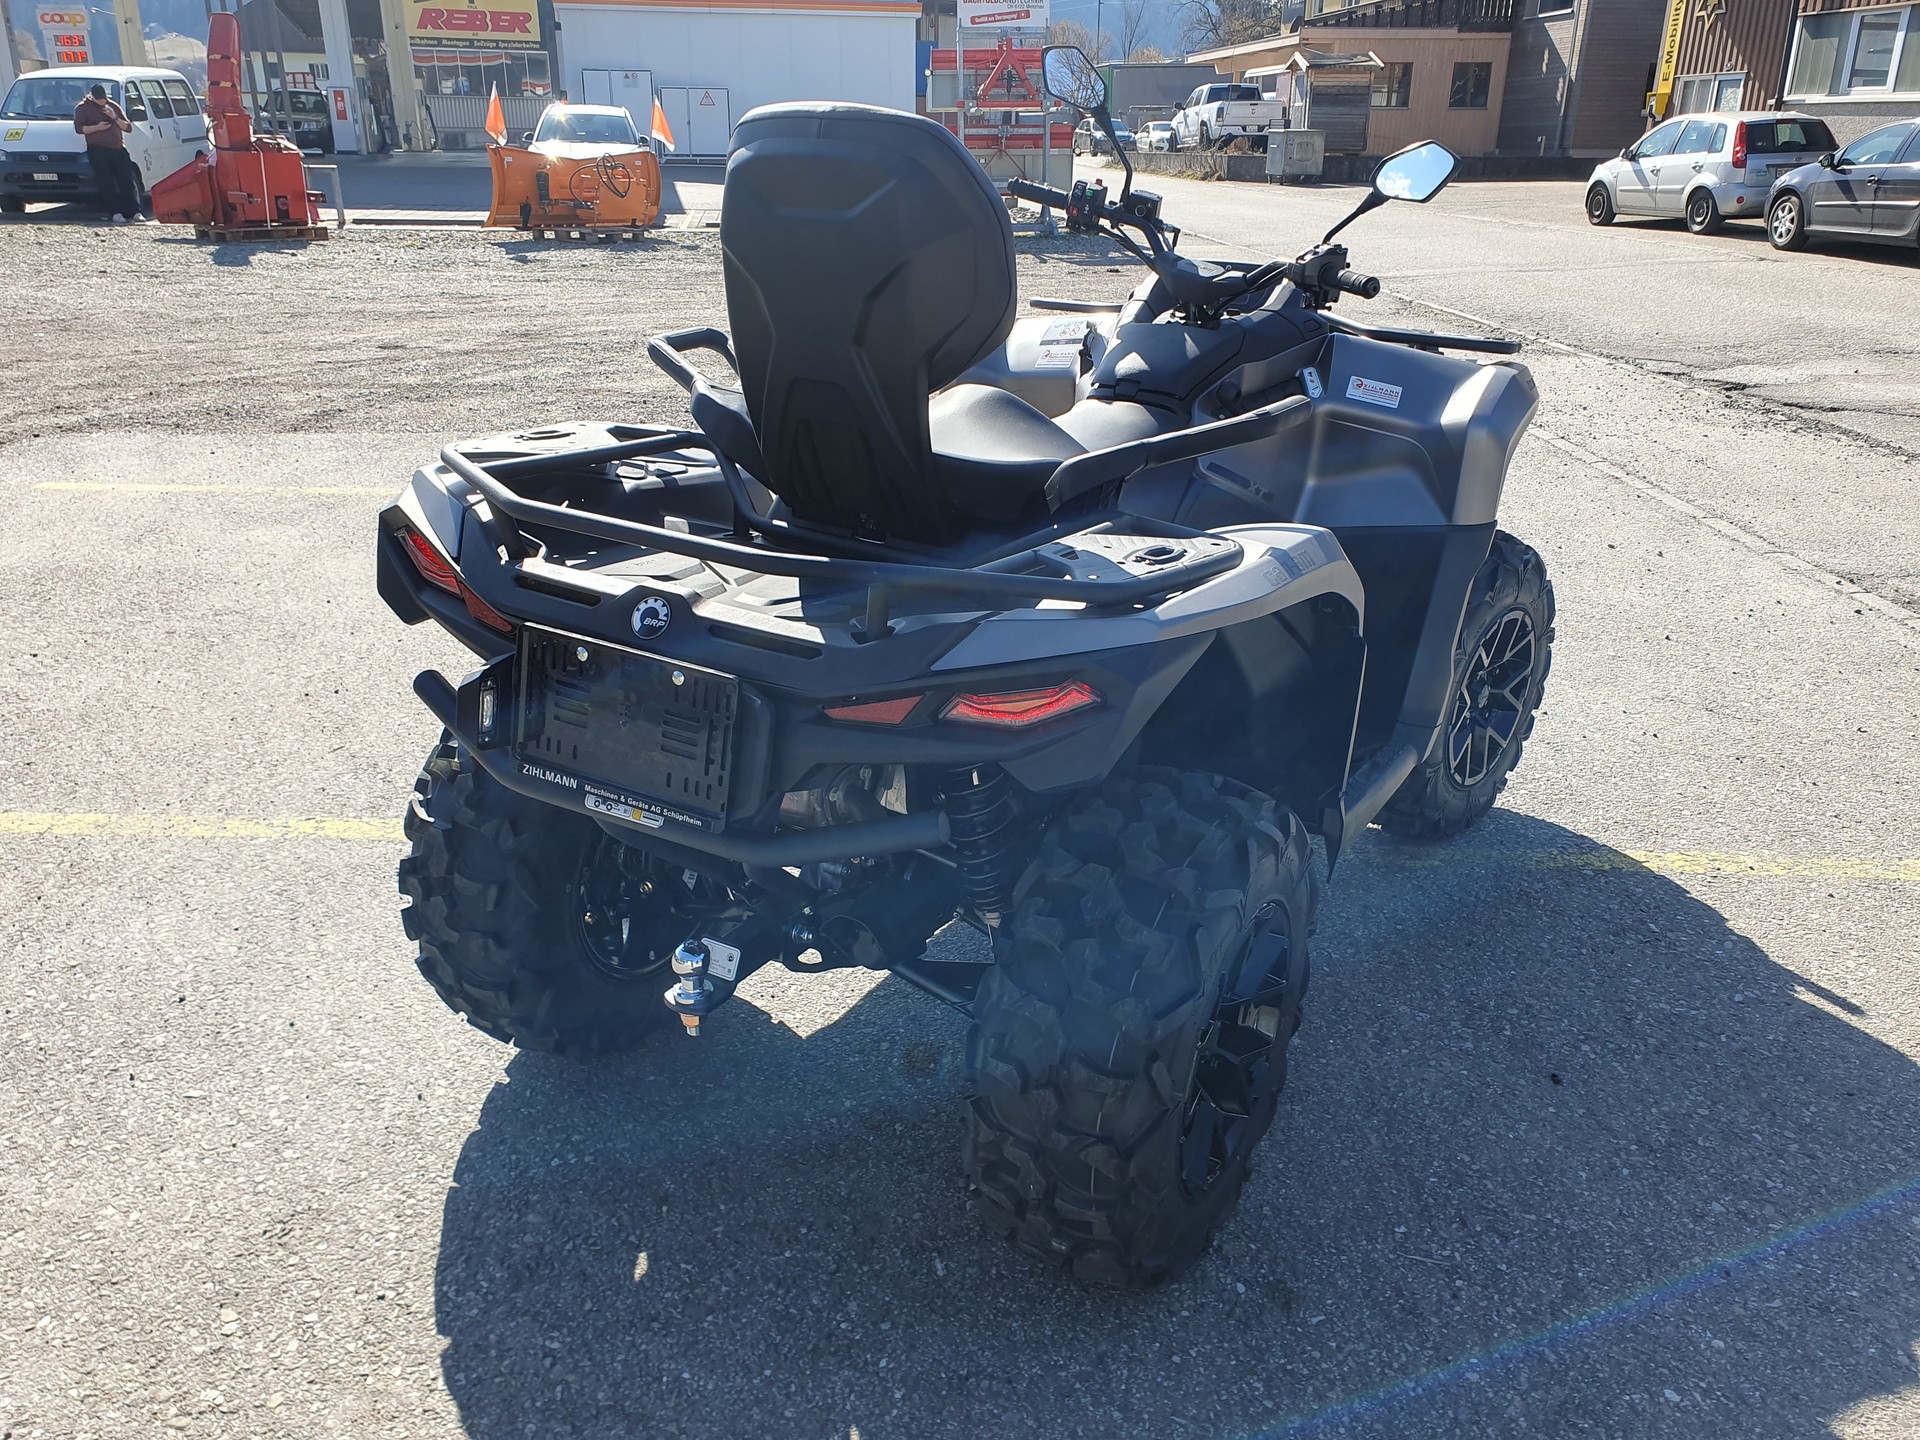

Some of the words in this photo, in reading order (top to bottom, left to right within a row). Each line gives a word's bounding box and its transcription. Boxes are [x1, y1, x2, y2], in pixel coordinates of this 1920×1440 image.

[40, 12, 86, 27] coop
[416, 8, 533, 34] REBER
[1662, 0, 1684, 82] E-Mobility
[643, 617, 666, 628] BRP
[522, 763, 578, 790] ZIHLMANN
[584, 784, 619, 801] Maschinen
[620, 795, 626, 803] &
[627, 797, 649, 811] Geräte
[650, 804, 661, 814] AG
[663, 808, 702, 827] Schüpfheim
